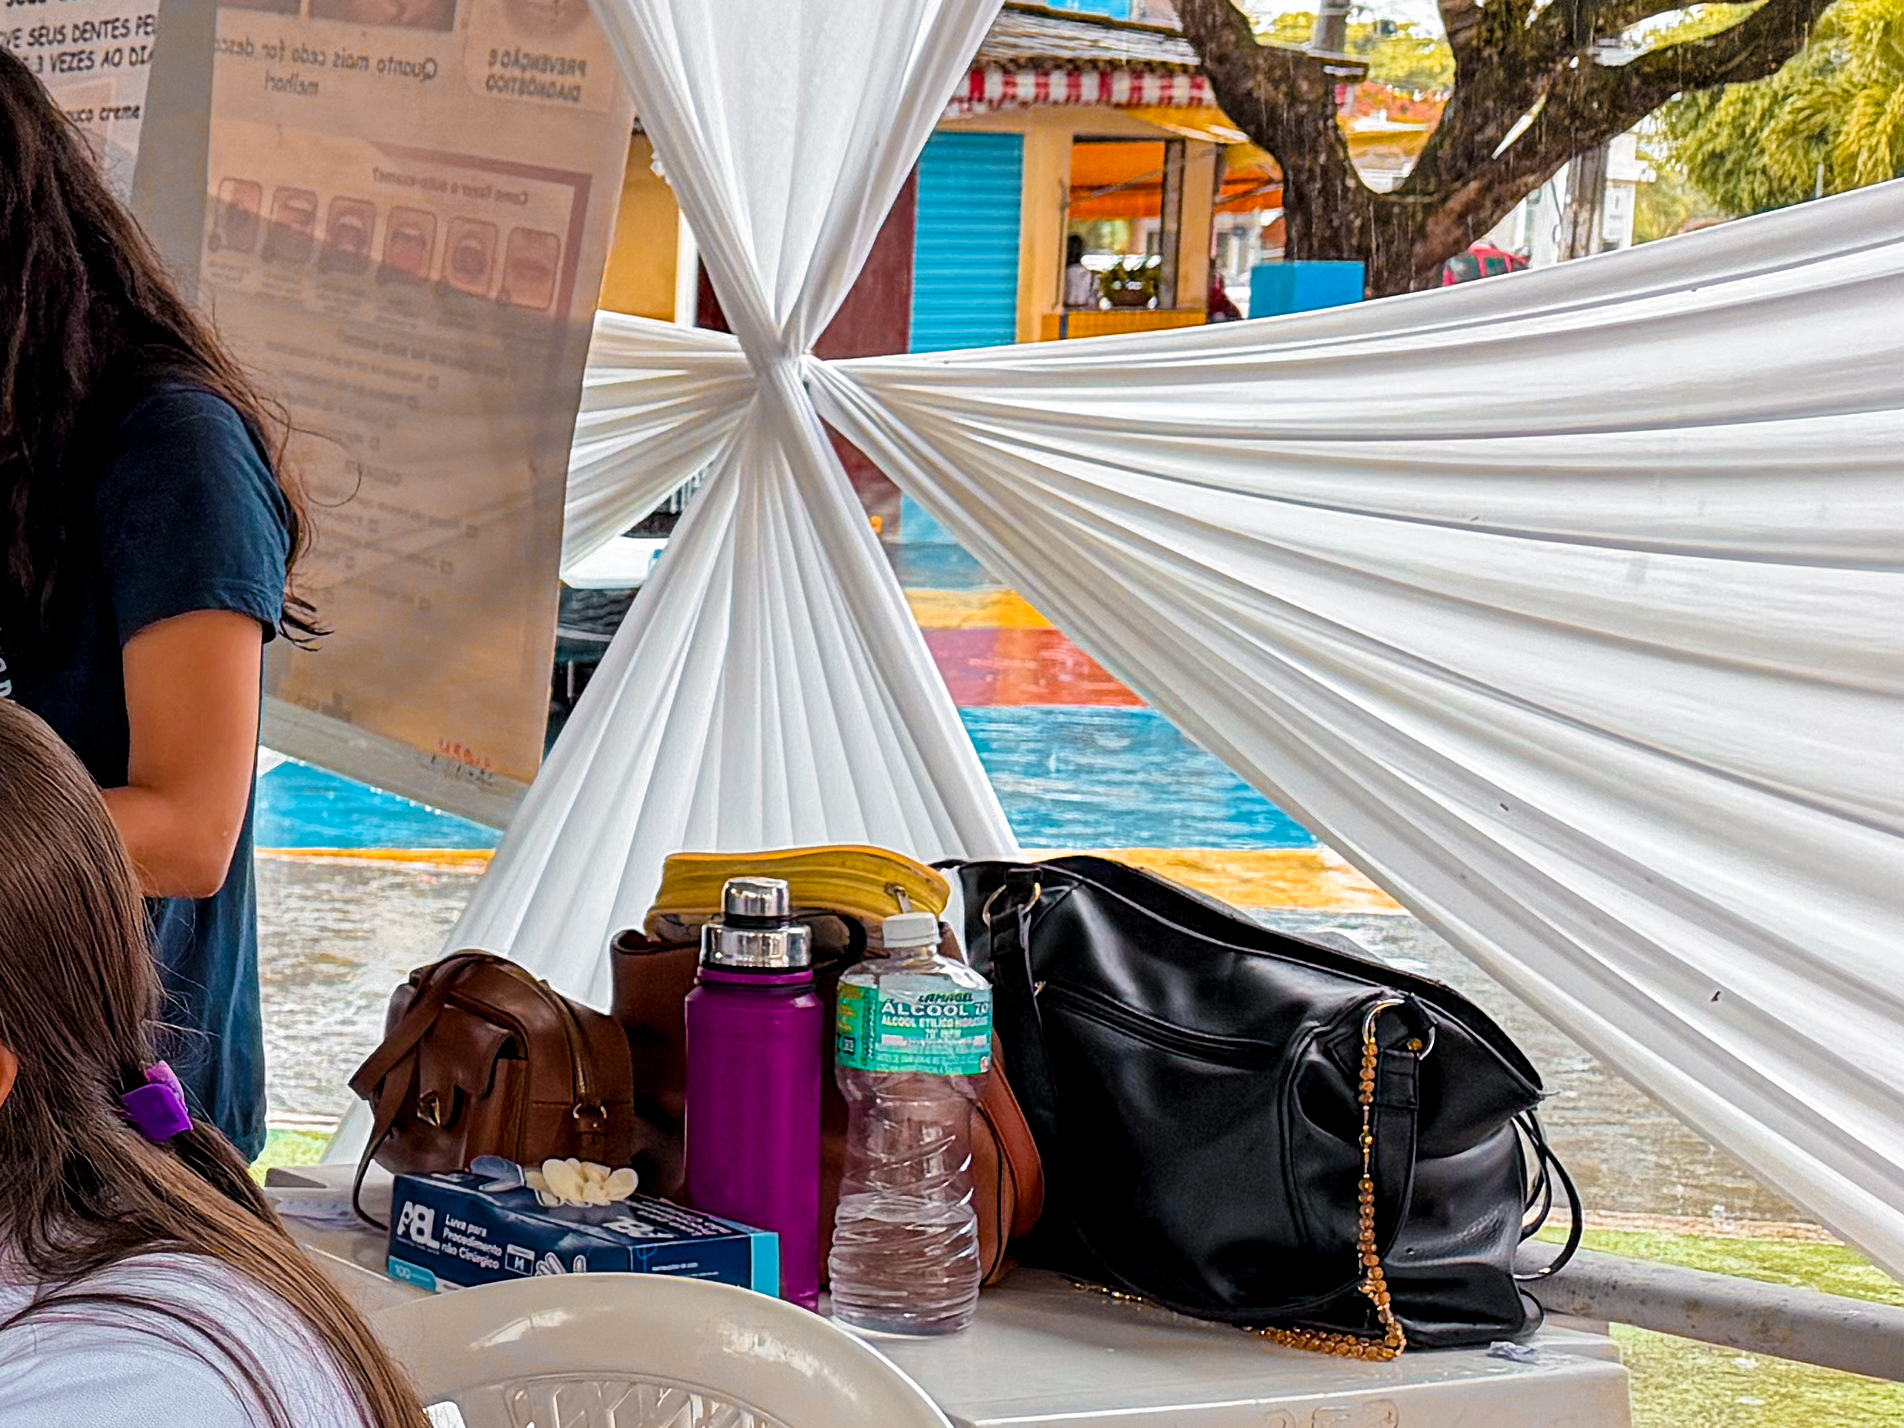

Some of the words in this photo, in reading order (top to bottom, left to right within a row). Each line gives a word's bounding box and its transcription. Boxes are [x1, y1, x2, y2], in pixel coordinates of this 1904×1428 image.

[27, 25, 66, 47] SEUS
[72, 18, 130, 43] DENTES
[882, 999, 969, 1017] ÁLCOOL
[397, 1201, 440, 1250] PBL
[445, 1214, 466, 1231] Luva
[467, 1223, 487, 1237] para
